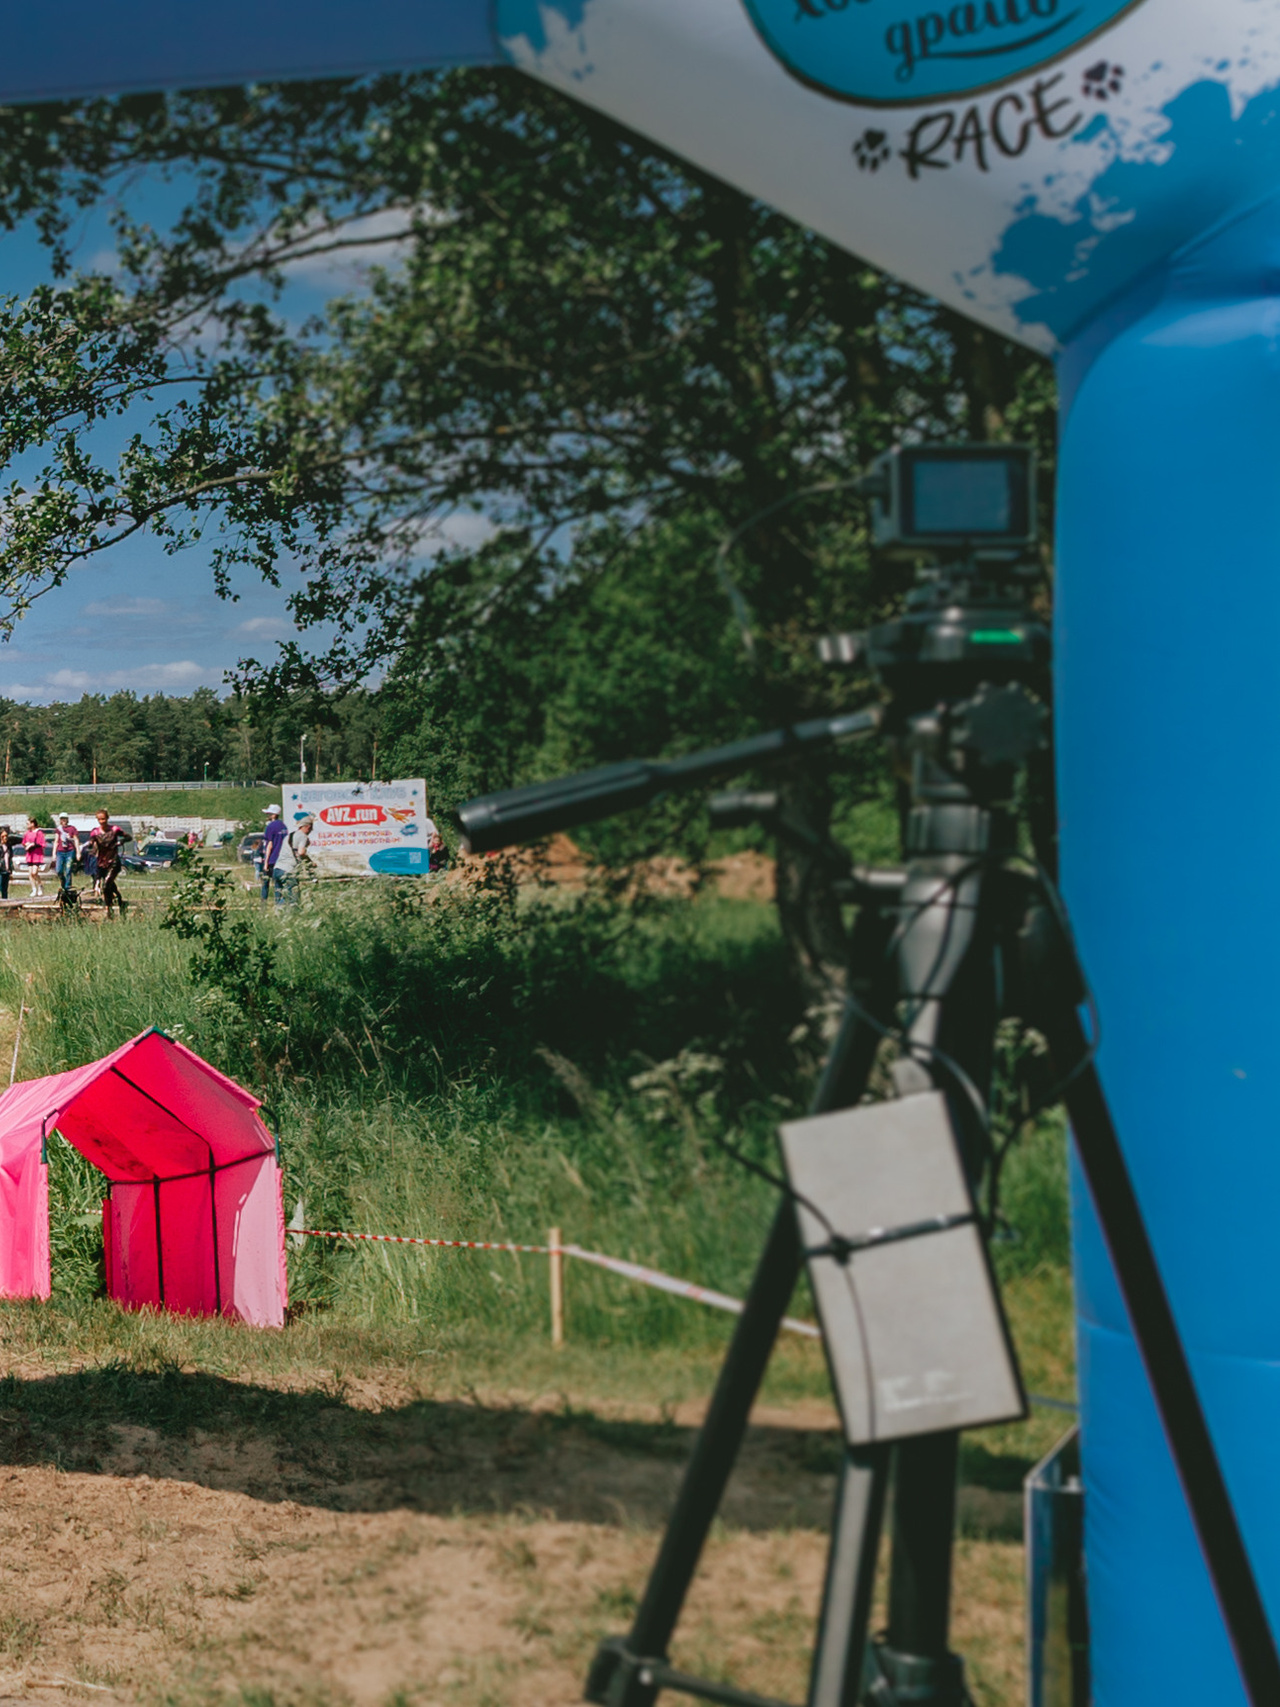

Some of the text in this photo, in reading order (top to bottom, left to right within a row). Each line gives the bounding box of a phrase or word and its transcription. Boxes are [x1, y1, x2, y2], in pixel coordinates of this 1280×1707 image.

[899, 71, 1083, 181] RACE
[301, 788, 364, 803] БЕГОВО
[326, 807, 378, 822] AVZ_run
